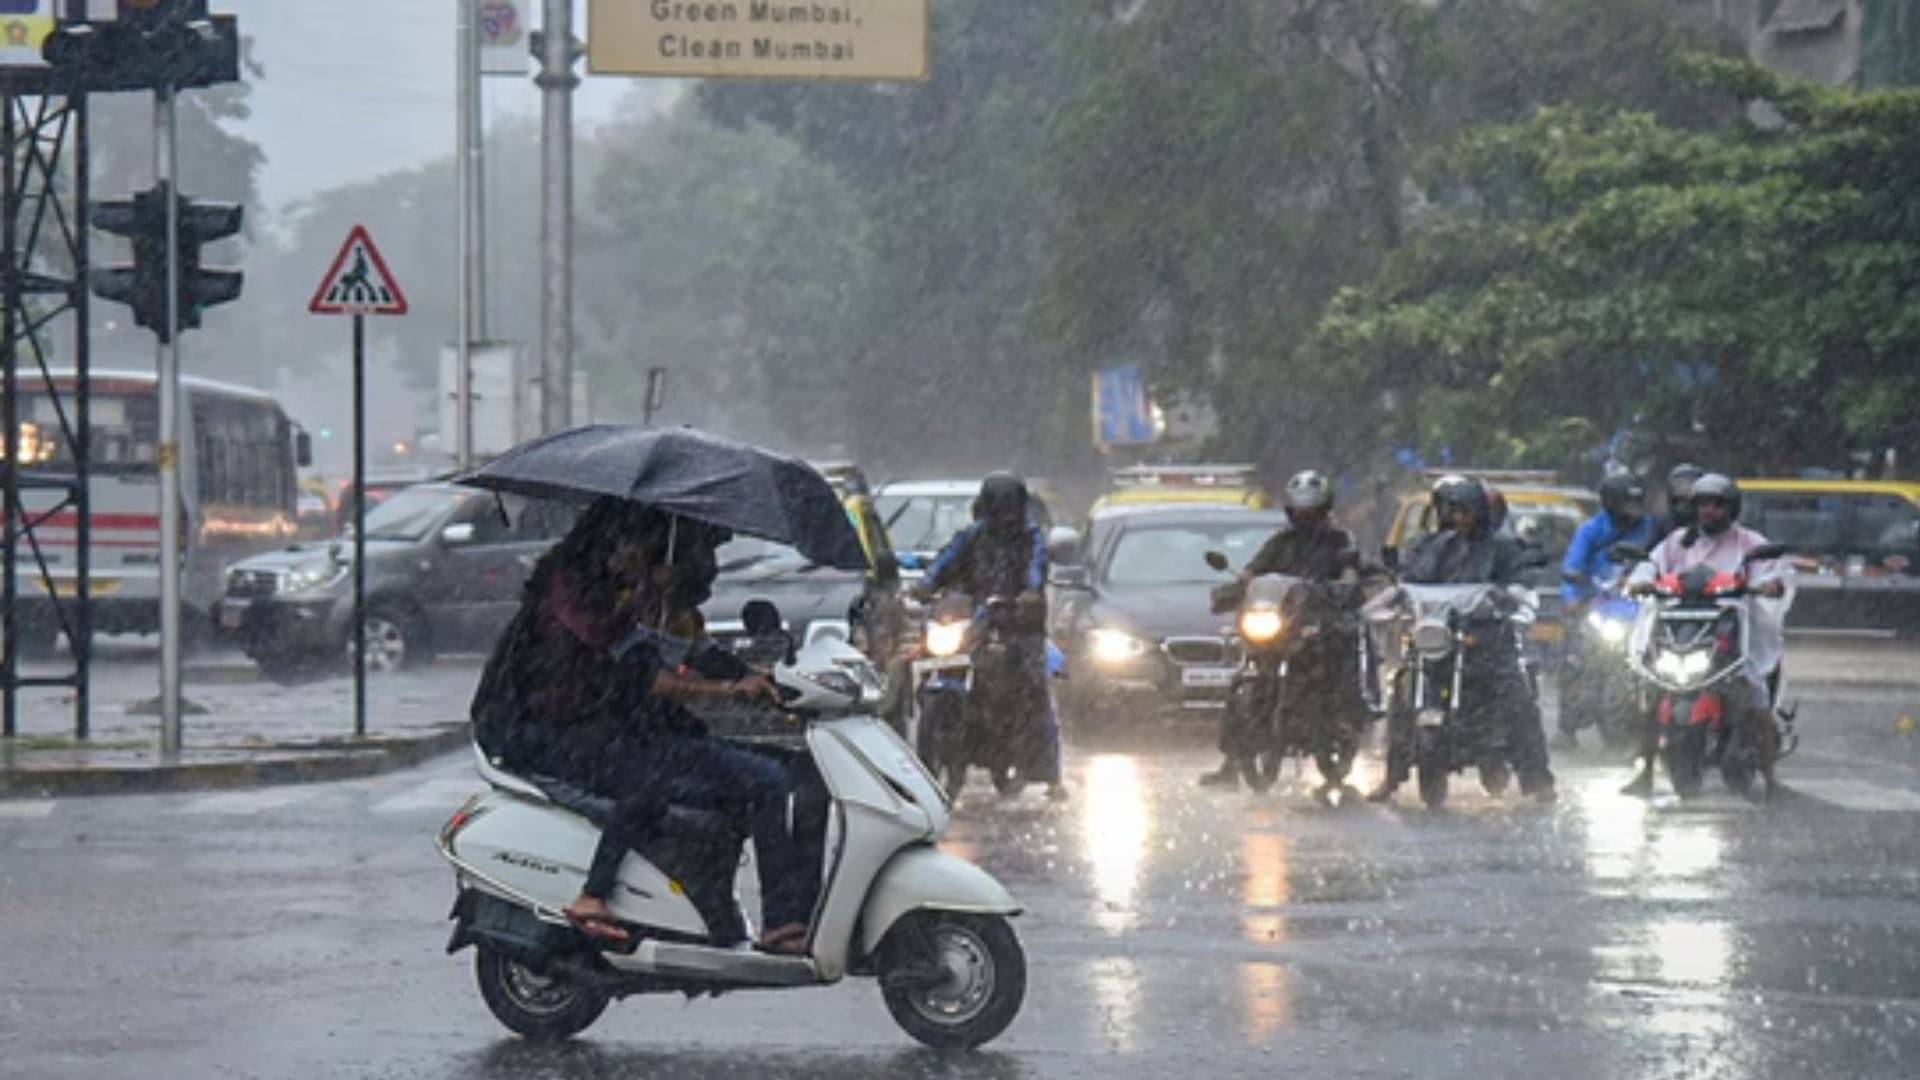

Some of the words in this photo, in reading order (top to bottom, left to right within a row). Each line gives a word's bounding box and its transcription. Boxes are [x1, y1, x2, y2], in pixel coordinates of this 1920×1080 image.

[651, 0, 737, 22] Green
[749, 0, 863, 28] Mumbai,
[657, 33, 741, 59] Clean
[752, 37, 855, 60] Mumbai
